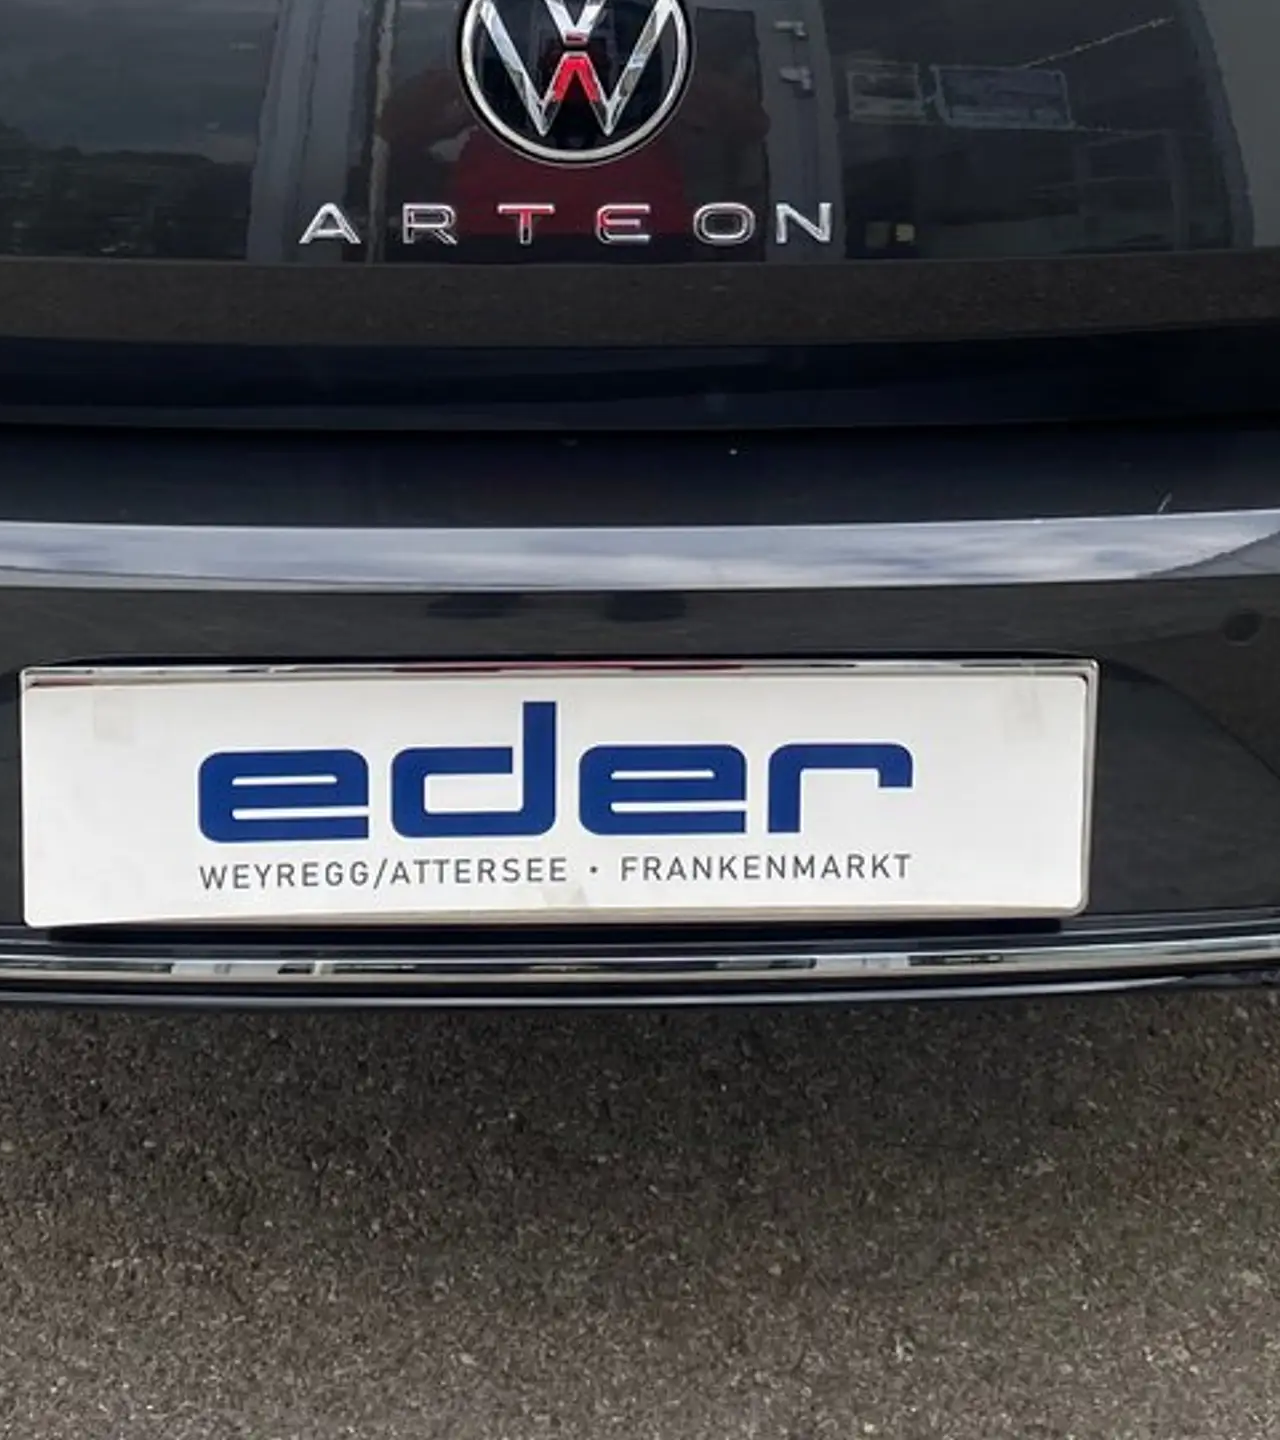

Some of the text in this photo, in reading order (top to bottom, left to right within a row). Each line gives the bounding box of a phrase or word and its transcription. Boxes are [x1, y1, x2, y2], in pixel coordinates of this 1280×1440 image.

[298, 202, 833, 245] ARTEON
[197, 701, 914, 843] eder
[198, 853, 912, 890] WEYREGG/ATTERSEE FRANKENMARKT
